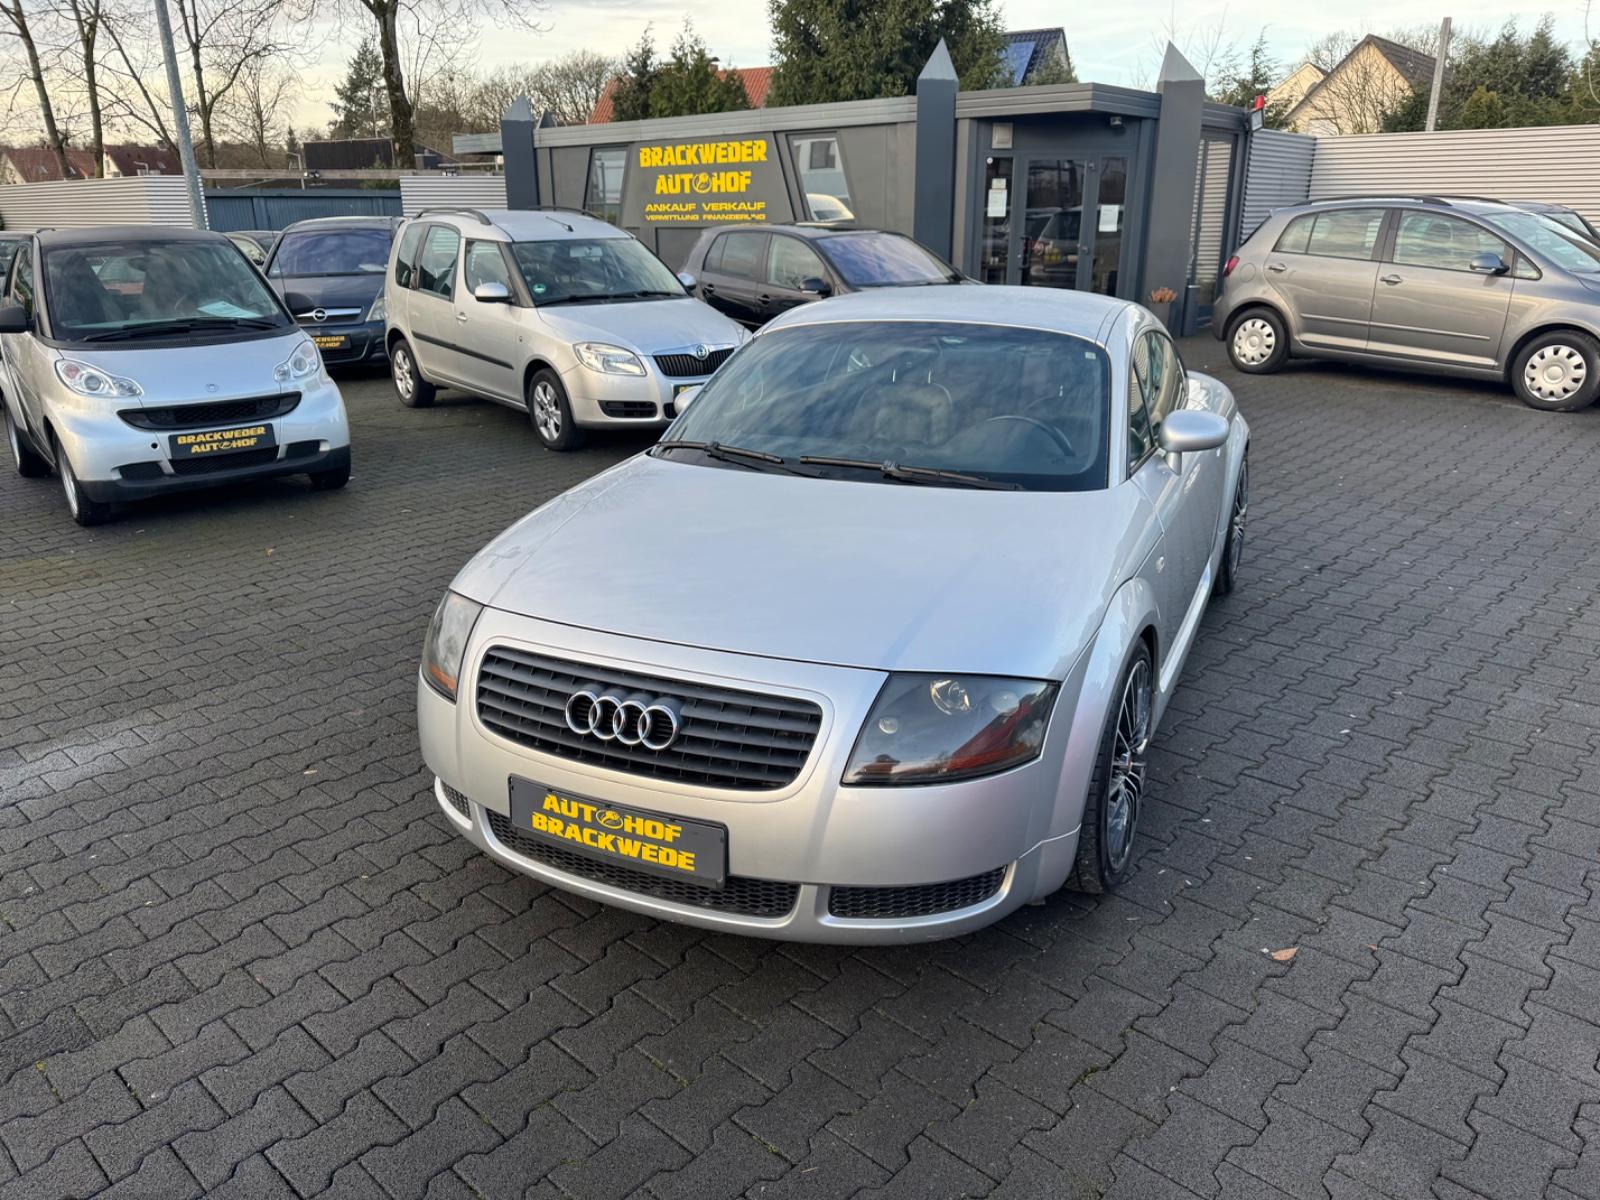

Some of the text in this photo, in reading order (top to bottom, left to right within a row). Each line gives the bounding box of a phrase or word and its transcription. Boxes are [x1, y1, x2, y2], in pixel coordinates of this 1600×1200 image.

[639, 139, 768, 168] BRACKWEDER
[645, 201, 766, 212] ANKAUF VERKAUF
[177, 426, 266, 445] BRACKWEDER
[531, 811, 696, 872] BRACKWEDE
